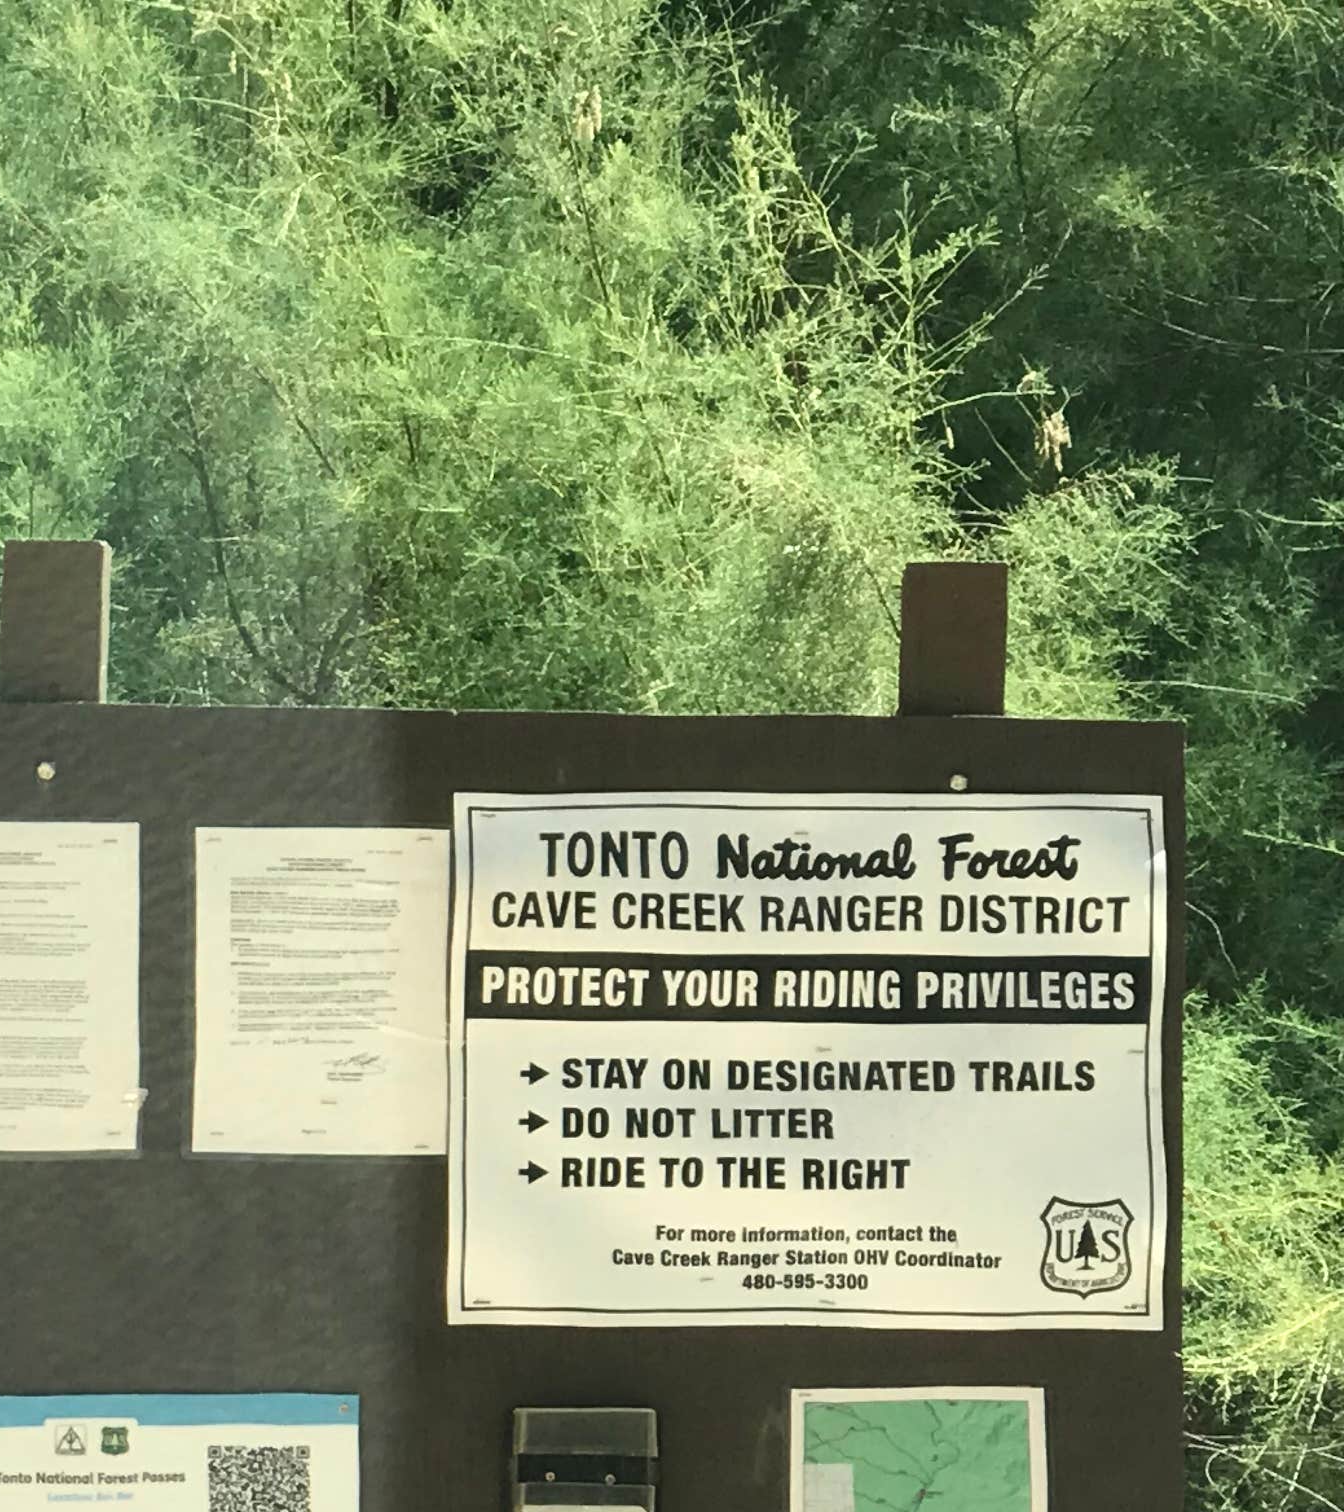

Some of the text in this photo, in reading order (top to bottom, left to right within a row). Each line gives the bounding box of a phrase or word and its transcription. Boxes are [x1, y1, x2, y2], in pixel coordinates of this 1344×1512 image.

[540, 831, 1081, 881] TONTO National Forest
[493, 891, 1129, 934] CAVE CREEK RANGER DISTRICT
[483, 966, 1134, 1009] PROTECT YOUR RIDING PRIVILEGES
[562, 1059, 1094, 1091] STAY ON DESIGNATED TRAILS
[563, 1108, 833, 1139] DO NOT LITTER
[562, 1157, 910, 1190] RIDE TO THE RIGHT
[656, 1225, 957, 1243] For more information, contact the
[612, 1249, 1001, 1269] Cave Creek Ranger Station OHV Coordinator
[742, 1274, 868, 1290] 480-595-3300
[36, 1471, 94, 1484] National
[98, 1472, 138, 1484] Forest
[142, 1471, 186, 1483] Passes
